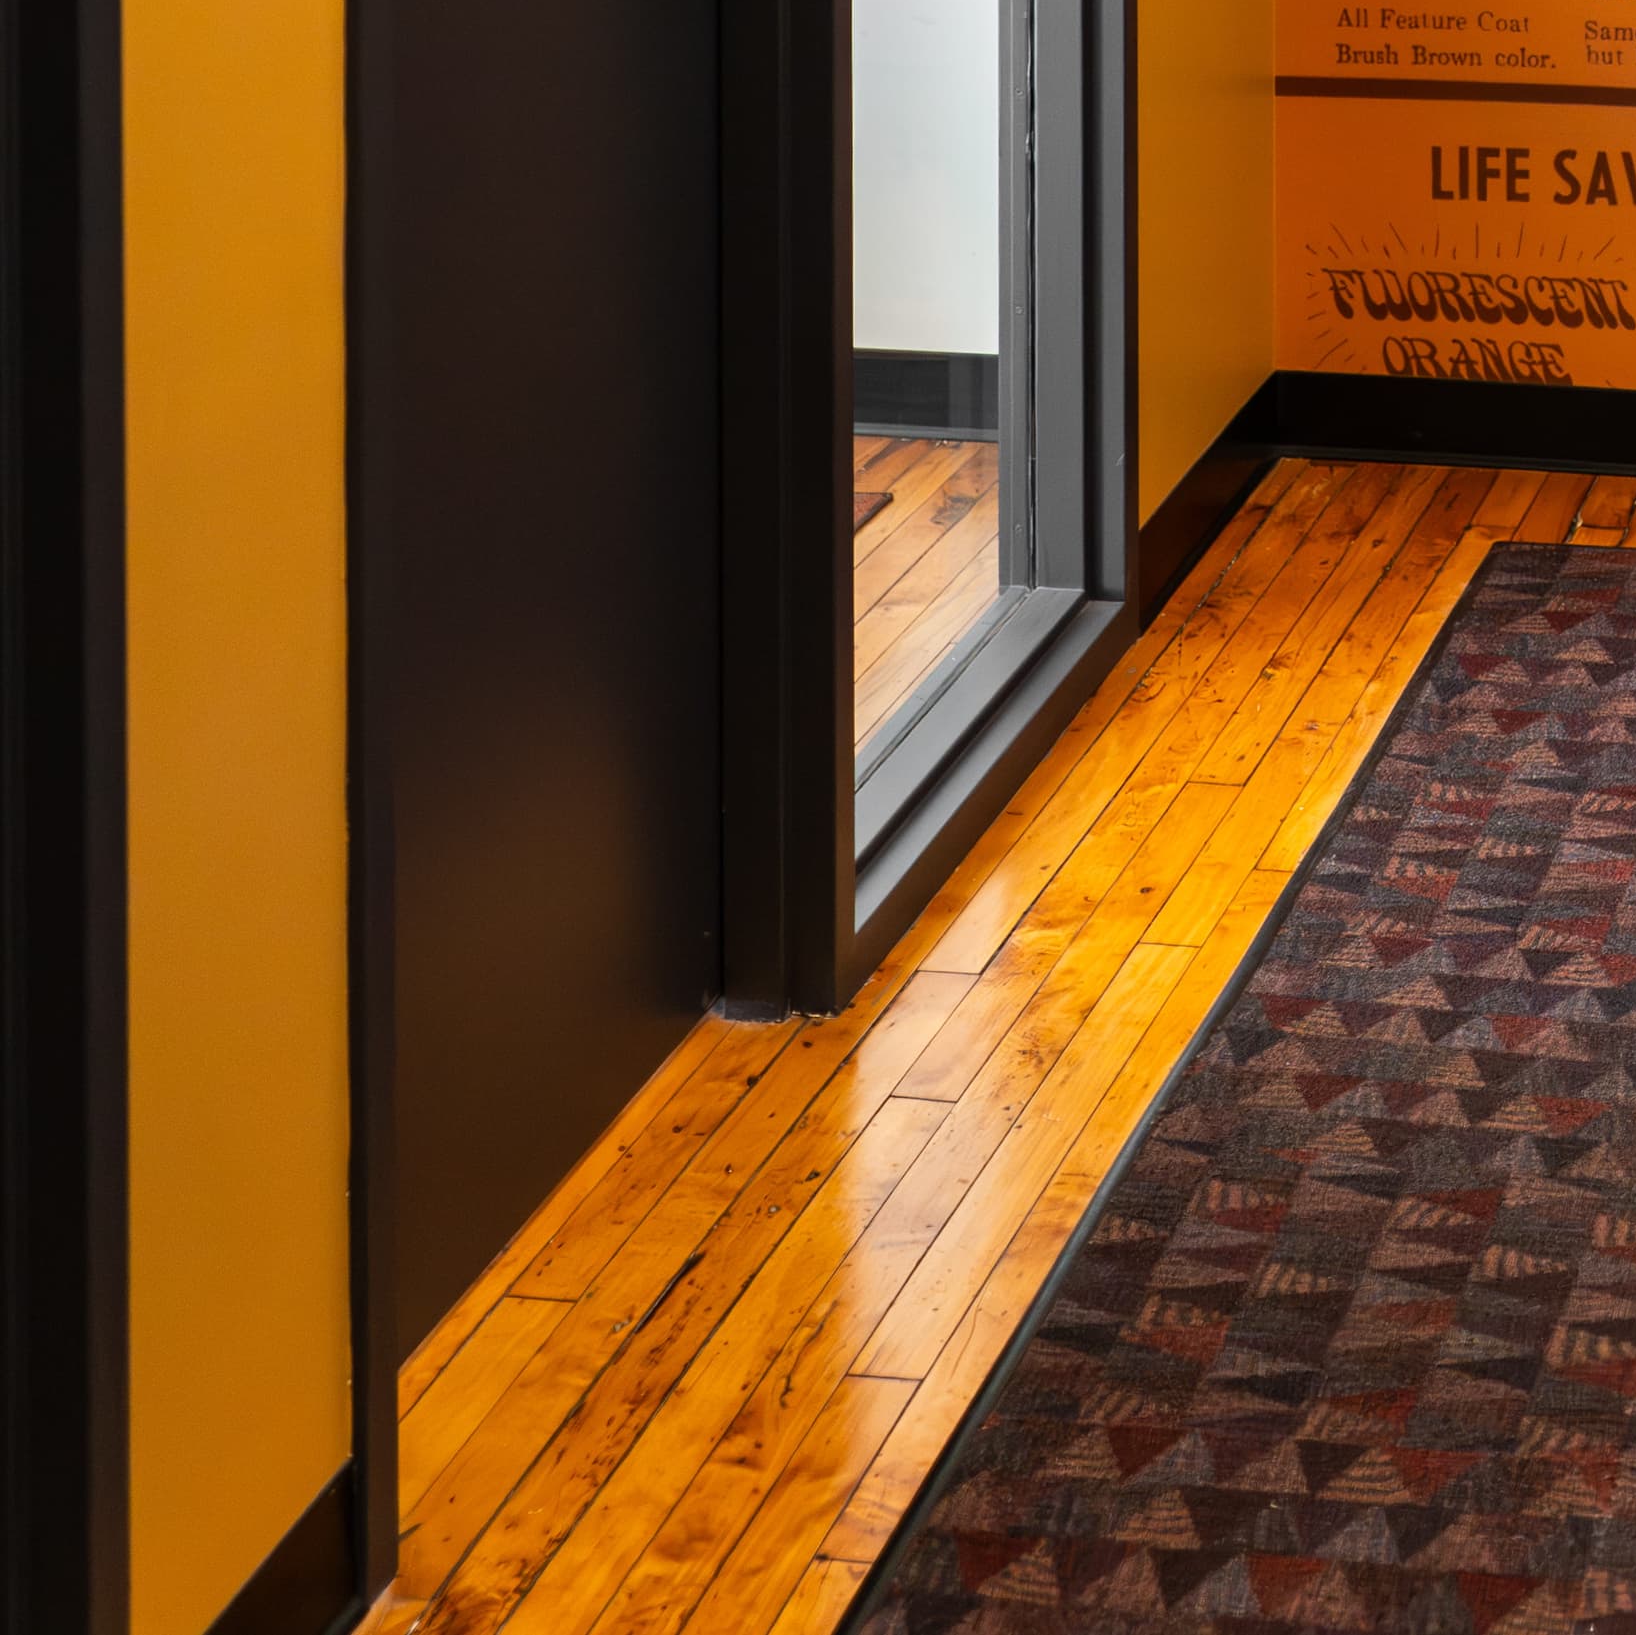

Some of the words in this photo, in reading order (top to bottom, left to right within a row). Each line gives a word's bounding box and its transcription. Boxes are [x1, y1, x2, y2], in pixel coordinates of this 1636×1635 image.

[1337, 8, 1368, 28] All
[1380, 8, 1467, 30] Feature
[1477, 11, 1528, 32] Coat
[1336, 42, 1399, 65] Brush
[1411, 44, 1482, 66] Brown
[1495, 47, 1556, 68] color.
[1586, 45, 1623, 65] but
[1431, 145, 1530, 202] LIFE
[1321, 267, 1636, 330] FLUORESCENT
[1382, 335, 1574, 387] ORANGE
